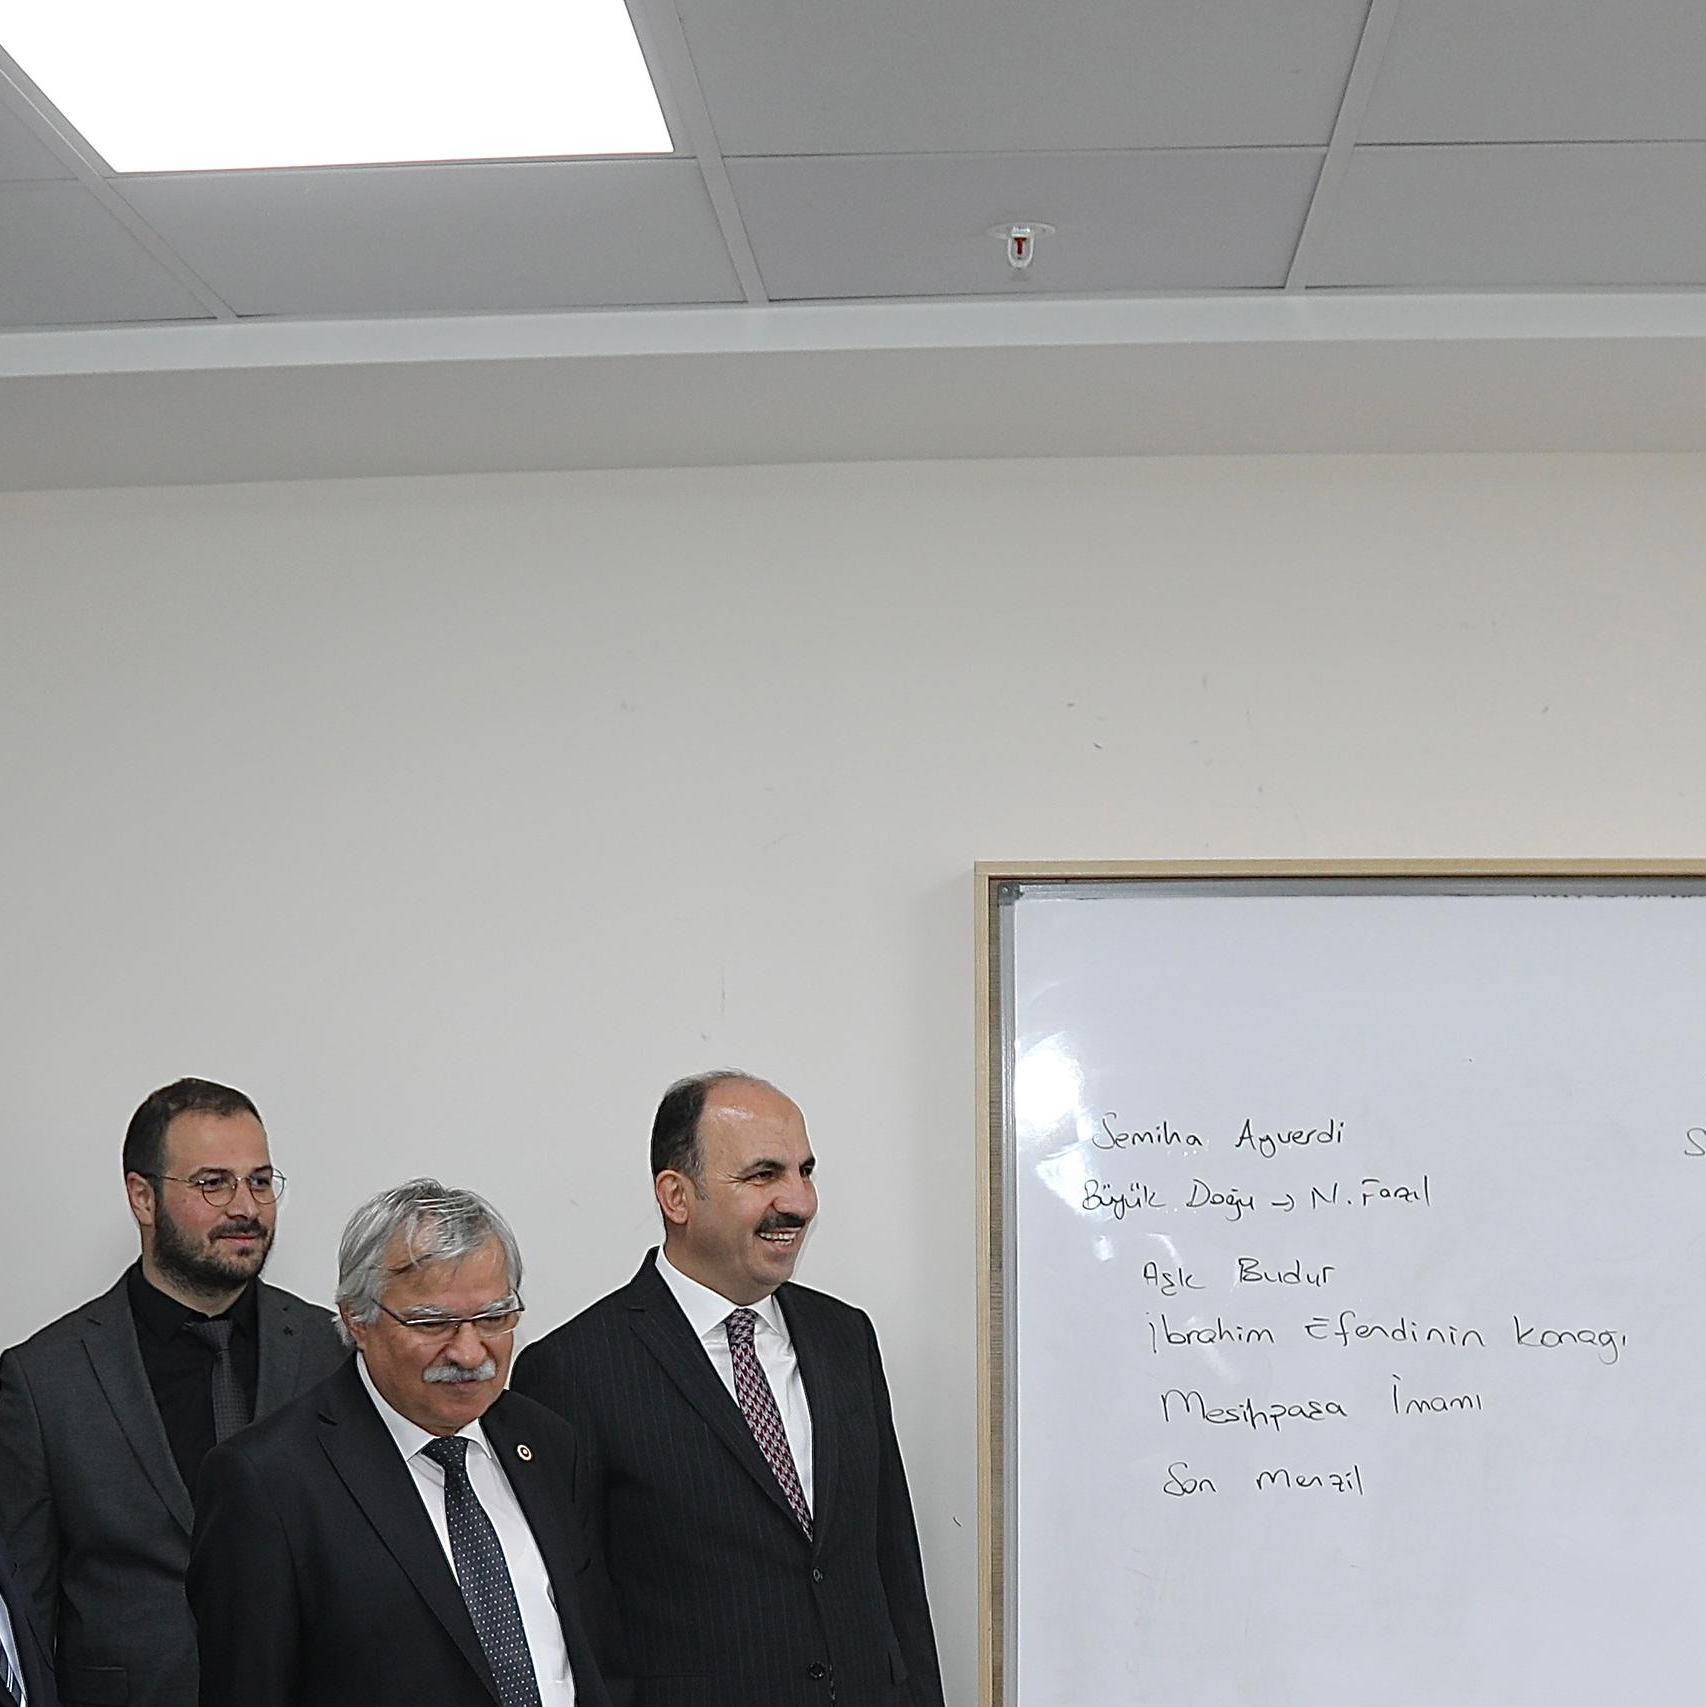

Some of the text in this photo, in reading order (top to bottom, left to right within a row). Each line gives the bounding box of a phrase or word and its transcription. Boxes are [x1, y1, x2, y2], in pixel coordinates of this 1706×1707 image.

[1092, 1112, 1346, 1159] Semiha Ayverdi
[1081, 1178, 1167, 1220] Büyük
[1238, 1257, 1336, 1288] Budur
[1303, 1311, 1486, 1347] Efendinin
[1162, 1461, 1218, 1497] Son
